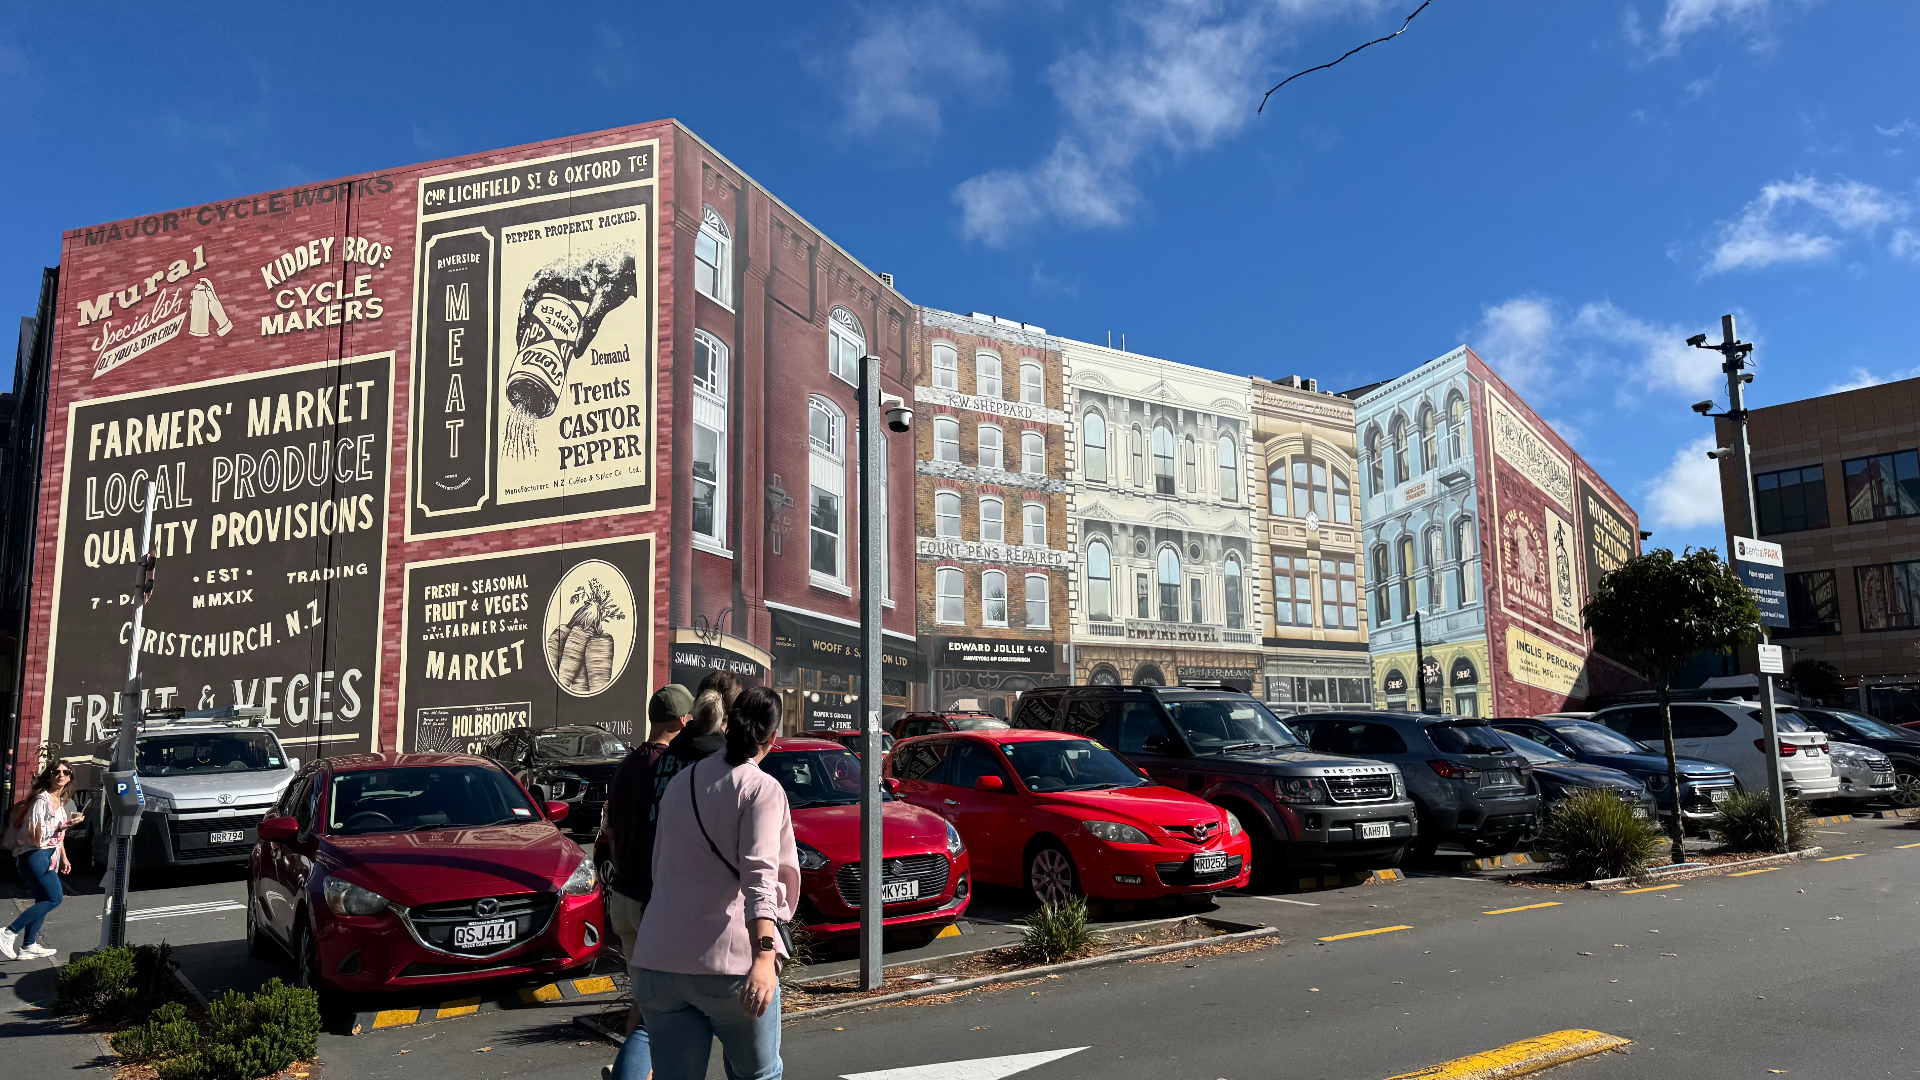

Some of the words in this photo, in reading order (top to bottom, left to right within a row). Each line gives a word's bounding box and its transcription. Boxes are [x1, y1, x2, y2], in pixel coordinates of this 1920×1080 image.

[448, 176, 520, 204] LICHFIELD
[548, 170, 558, 186] &
[565, 159, 621, 183] OXFORD
[197, 194, 284, 226] CYCLE
[293, 175, 394, 208] WORKS
[505, 229, 542, 244] PEPPER
[545, 219, 594, 238] PROPERLY
[598, 210, 640, 229] PACKED.
[261, 237, 334, 289] KIDDEY
[437, 253, 481, 269] RIVERSIDE
[77, 246, 208, 326] Mural
[276, 275, 372, 308] CYCLE
[92, 288, 183, 352] Specialists
[261, 298, 383, 335] MAKERS
[540, 304, 577, 333] PEPPER
[545, 316, 568, 336] WHITE
[112, 344, 133, 364] YOU
[133, 342, 139, 352] &
[141, 332, 157, 349] DTR
[158, 319, 182, 340] CREW
[591, 344, 630, 366] Demand
[445, 283, 470, 458] MEAT
[570, 377, 630, 405] Trents
[88, 402, 232, 461] FARMERS'
[247, 380, 375, 438] MARKET
[973, 399, 1032, 418] SHEPPARD
[559, 404, 640, 440] CASTOR
[558, 435, 641, 470] PEPPER
[86, 462, 192, 521] LOCAL
[211, 434, 375, 503] PRODUCE
[1505, 509, 1517, 524] THE
[1588, 495, 1631, 550] RIVERSIDE
[84, 518, 198, 568] QUAITY
[210, 493, 374, 549] PROVISIONS
[1504, 525, 1510, 537] IS
[1519, 510, 1544, 558] GARDEN
[920, 540, 959, 556] FOUNT
[968, 544, 999, 559] PENS
[1006, 549, 1062, 564] REPAIRED
[207, 568, 239, 584] EST
[287, 563, 368, 584] TRADING
[193, 589, 253, 608] MMXIX
[424, 583, 459, 600] FRESH
[472, 574, 529, 594] SEASONAL
[425, 600, 467, 623] FRUIT
[471, 599, 479, 611] &
[485, 593, 529, 615] VEGES
[445, 619, 505, 638] FARMERS
[507, 623, 528, 632] WEEK
[1126, 621, 1177, 640] EMPIRE
[1178, 625, 1219, 643] HOTEL
[425, 639, 525, 681] MARKET
[812, 640, 842, 654] WOOFF
[846, 647, 851, 655] &
[895, 655, 907, 666] LTD
[949, 642, 990, 652] EDWARD
[994, 644, 1024, 653] JOLLIE
[675, 652, 706, 667] SAMMY'S
[708, 657, 726, 671] JAZZ
[730, 660, 756, 676] REVIEW
[232, 668, 362, 727] VEGES
[452, 711, 527, 737] HOLBROOK'S
[117, 783, 127, 793] P
[211, 832, 243, 844] NRR794
[1363, 825, 1388, 837] KAH971
[1194, 856, 1226, 872] MRD252
[456, 923, 512, 943] QSJ441
